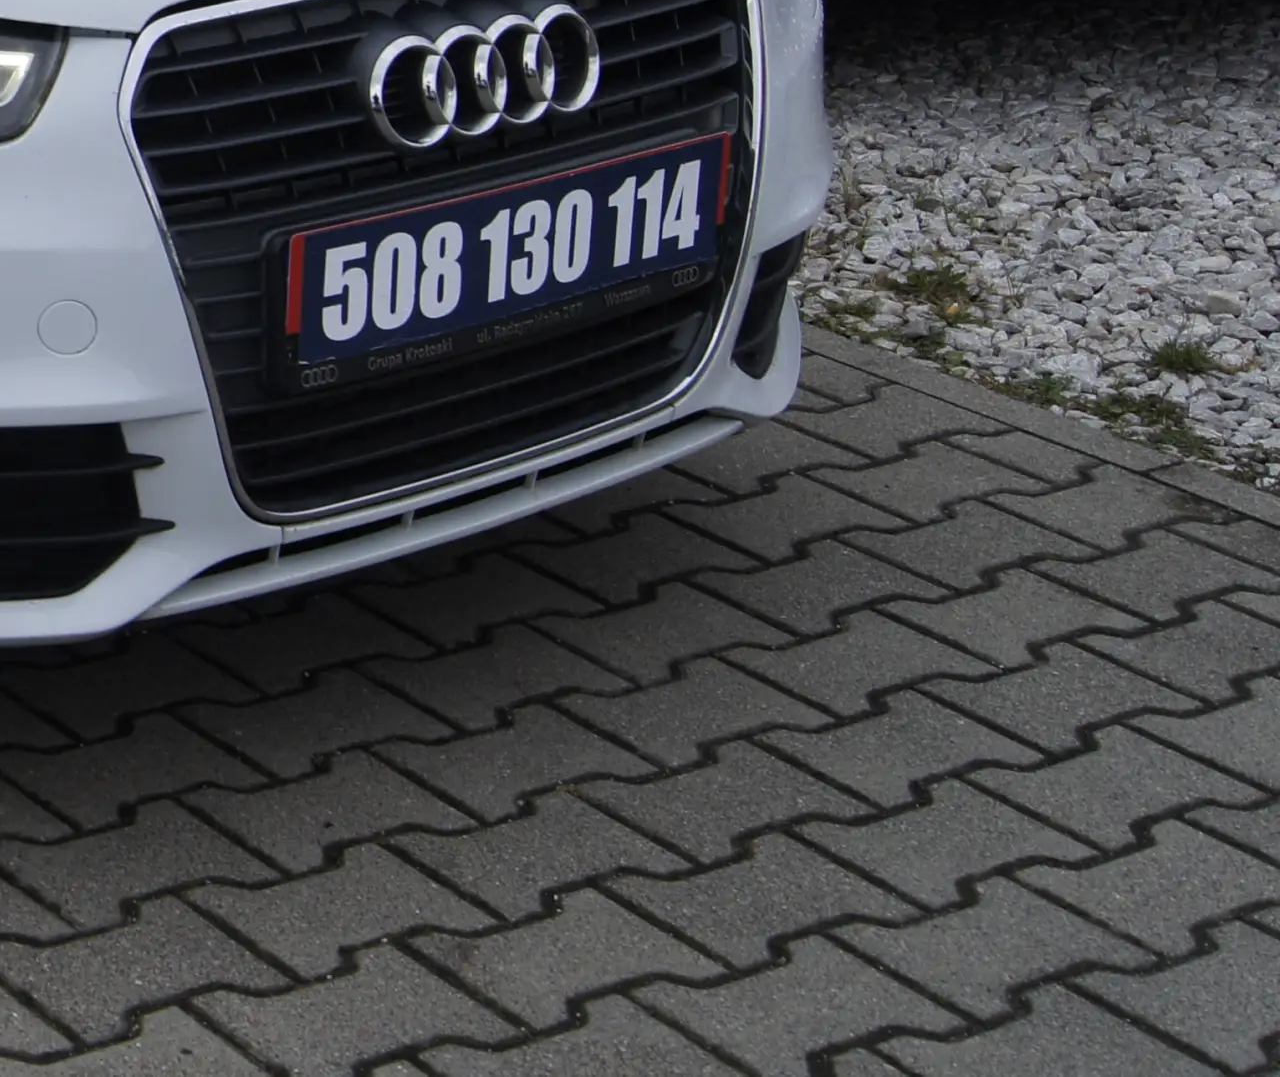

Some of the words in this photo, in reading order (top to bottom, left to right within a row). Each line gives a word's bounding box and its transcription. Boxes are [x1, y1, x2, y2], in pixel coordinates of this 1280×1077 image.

[321, 221, 464, 341] 508
[480, 187, 594, 303] 130
[608, 159, 701, 268] 114
